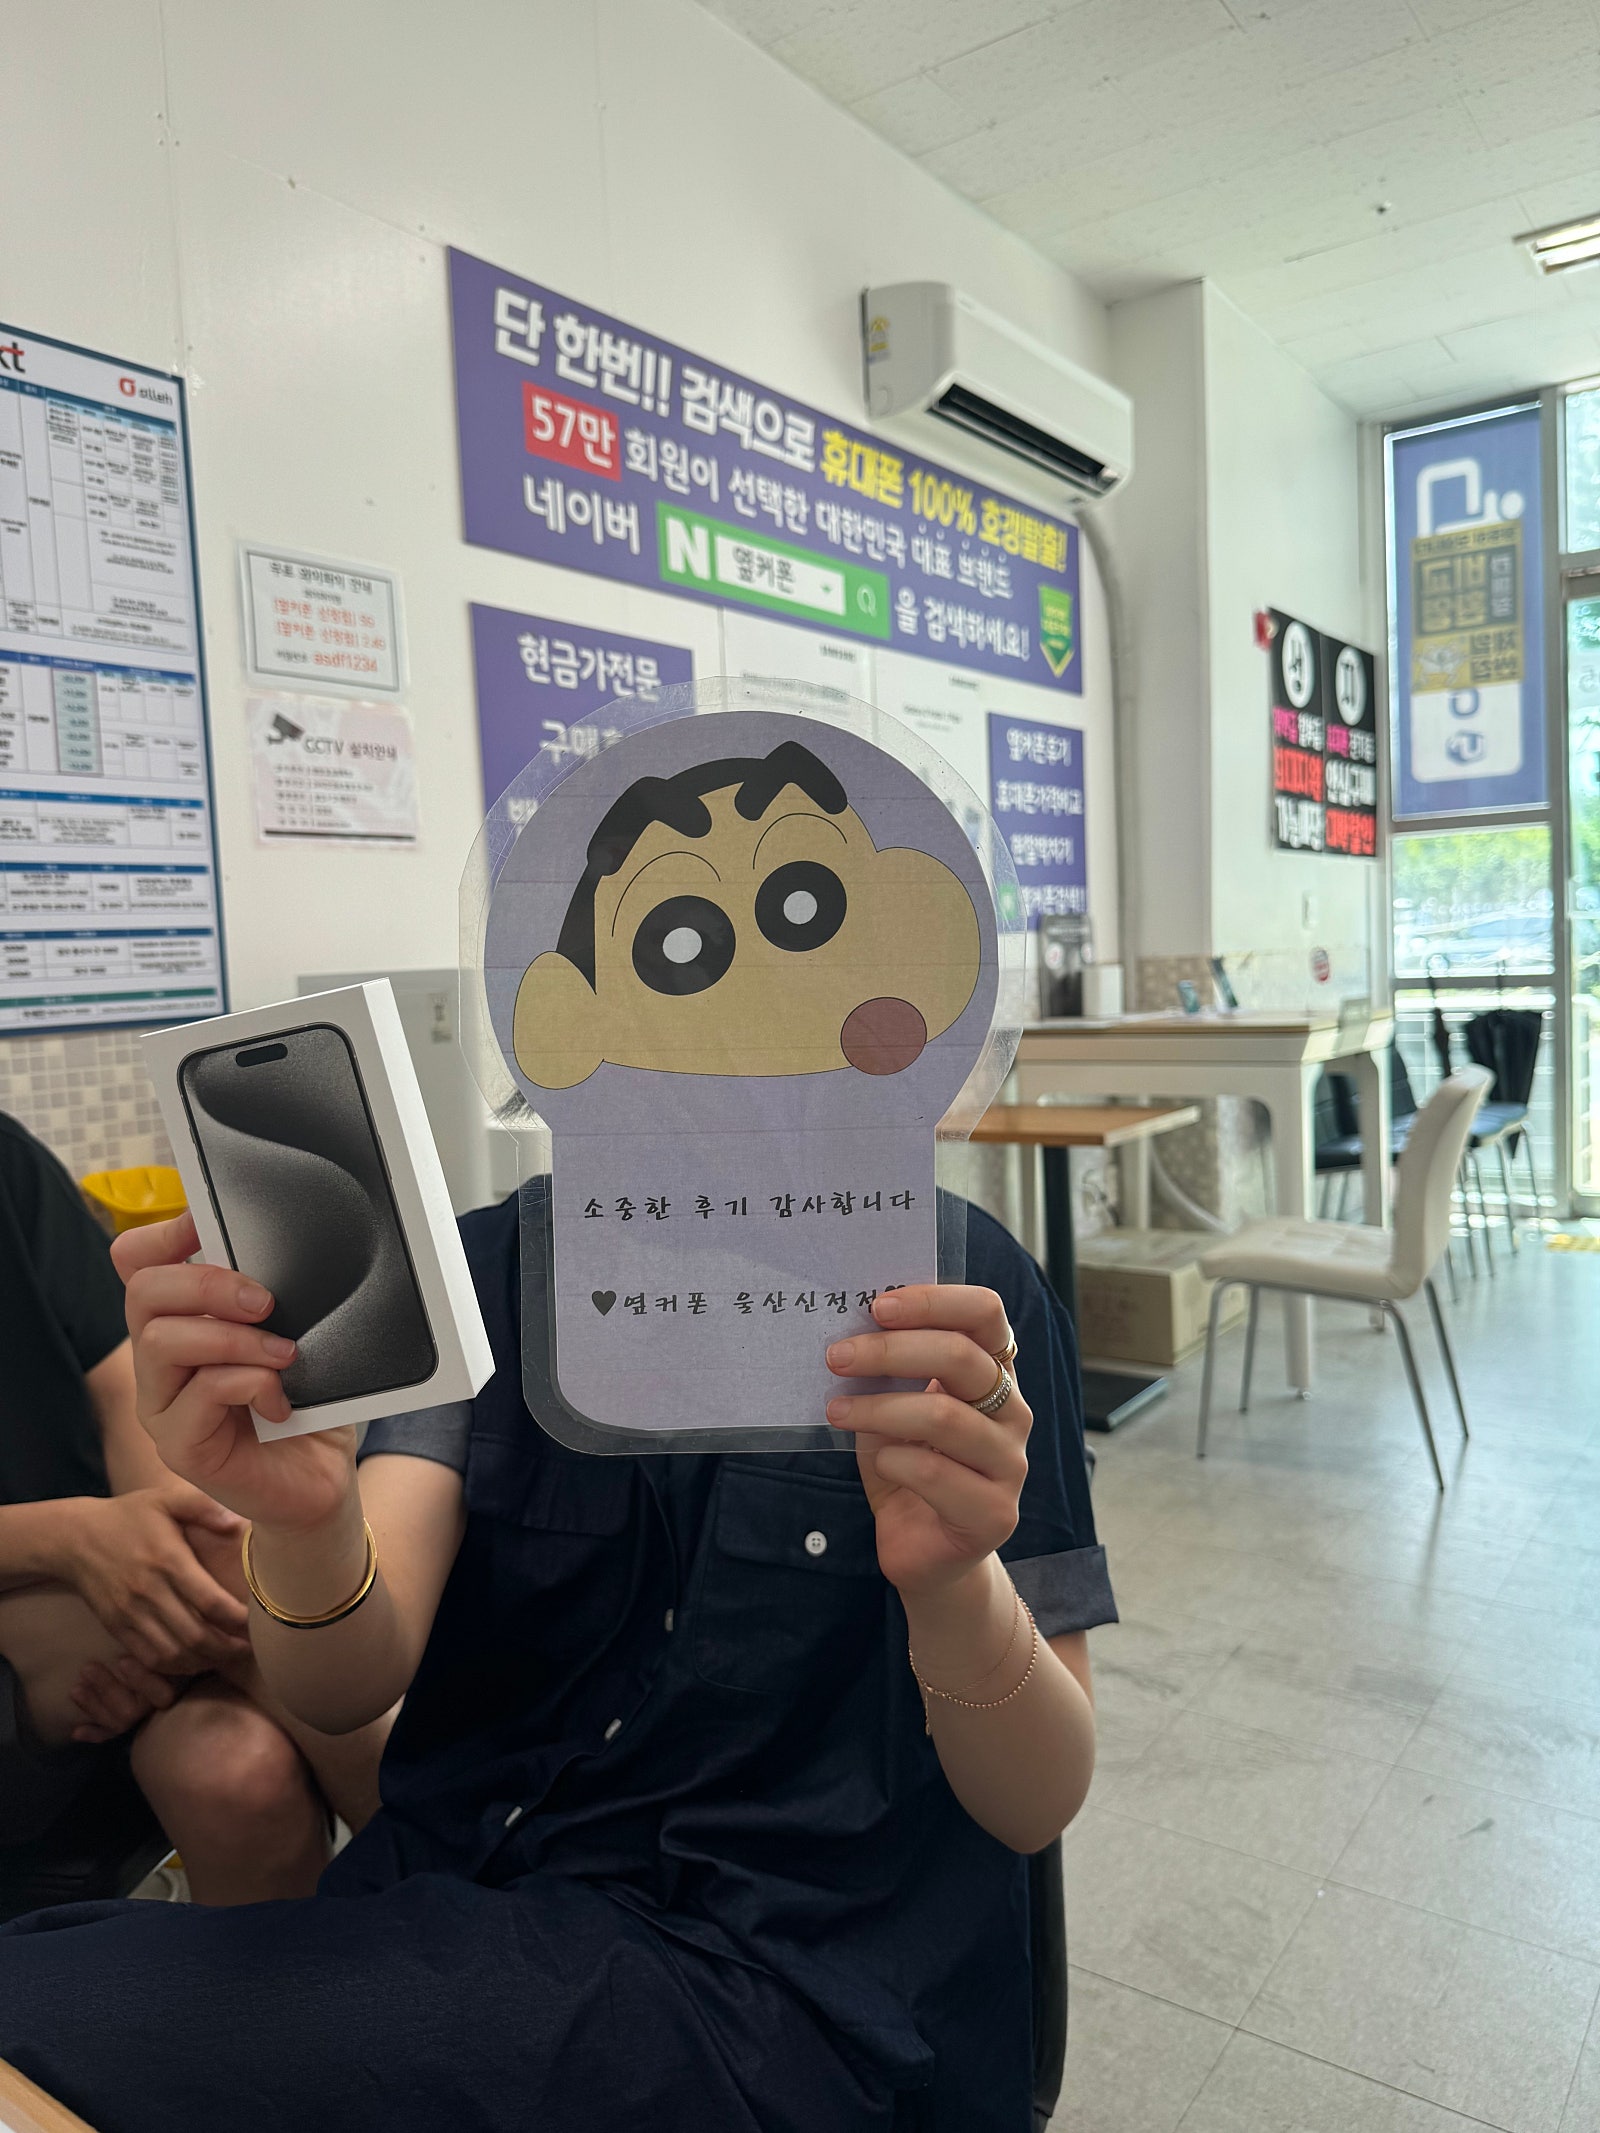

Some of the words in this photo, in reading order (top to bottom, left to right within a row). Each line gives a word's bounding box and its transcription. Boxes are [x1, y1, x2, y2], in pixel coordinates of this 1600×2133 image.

[494, 286, 546, 367] 단
[553, 313, 672, 417] 한번!!
[680, 365, 816, 473] 검색으로
[820, 428, 904, 509] 휴대폰
[908, 467, 977, 536] 100%
[531, 393, 617, 470] 57만
[624, 426, 720, 503] 회원이
[728, 466, 811, 536] 선택한
[815, 500, 907, 569] 대한민국
[911, 532, 954, 580] 대표
[957, 553, 1014, 600] 브랜드
[523, 472, 641, 555] 네이버
[665, 515, 712, 581] N
[895, 586, 919, 636] 을
[924, 595, 1031, 662] 검색하세요!
[313, 651, 378, 672] asdf1234
[517, 632, 662, 702] 현금가전문
[303, 735, 345, 757] CCTV
[584, 1197, 671, 1221] 소중한
[694, 1195, 748, 1219] 후기
[769, 1190, 916, 1218] 감사합니다
[623, 1291, 708, 1316] 옆커폰
